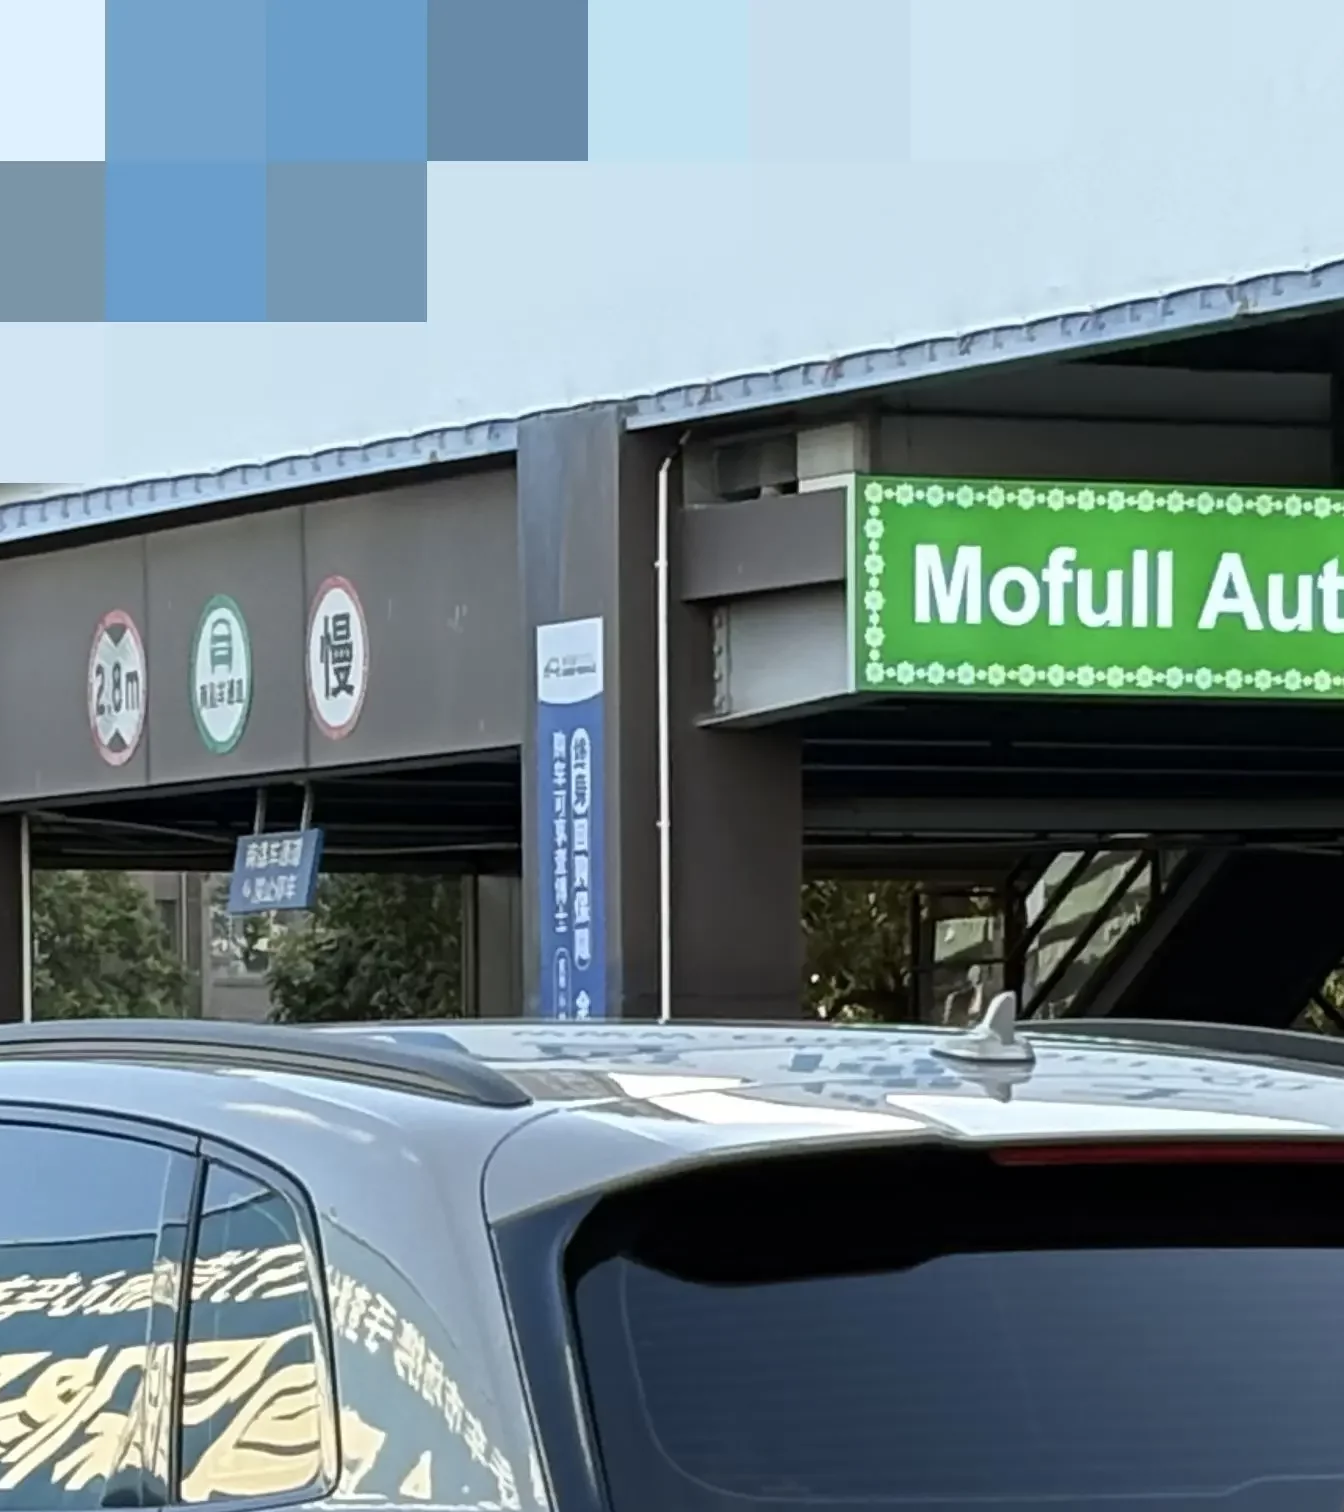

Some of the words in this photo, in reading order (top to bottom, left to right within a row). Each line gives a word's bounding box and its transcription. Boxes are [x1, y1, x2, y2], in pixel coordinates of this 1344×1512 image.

[913, 543, 1174, 628] Mofull
[96, 661, 140, 716] 2.8m
[319, 612, 355, 701] 慢
